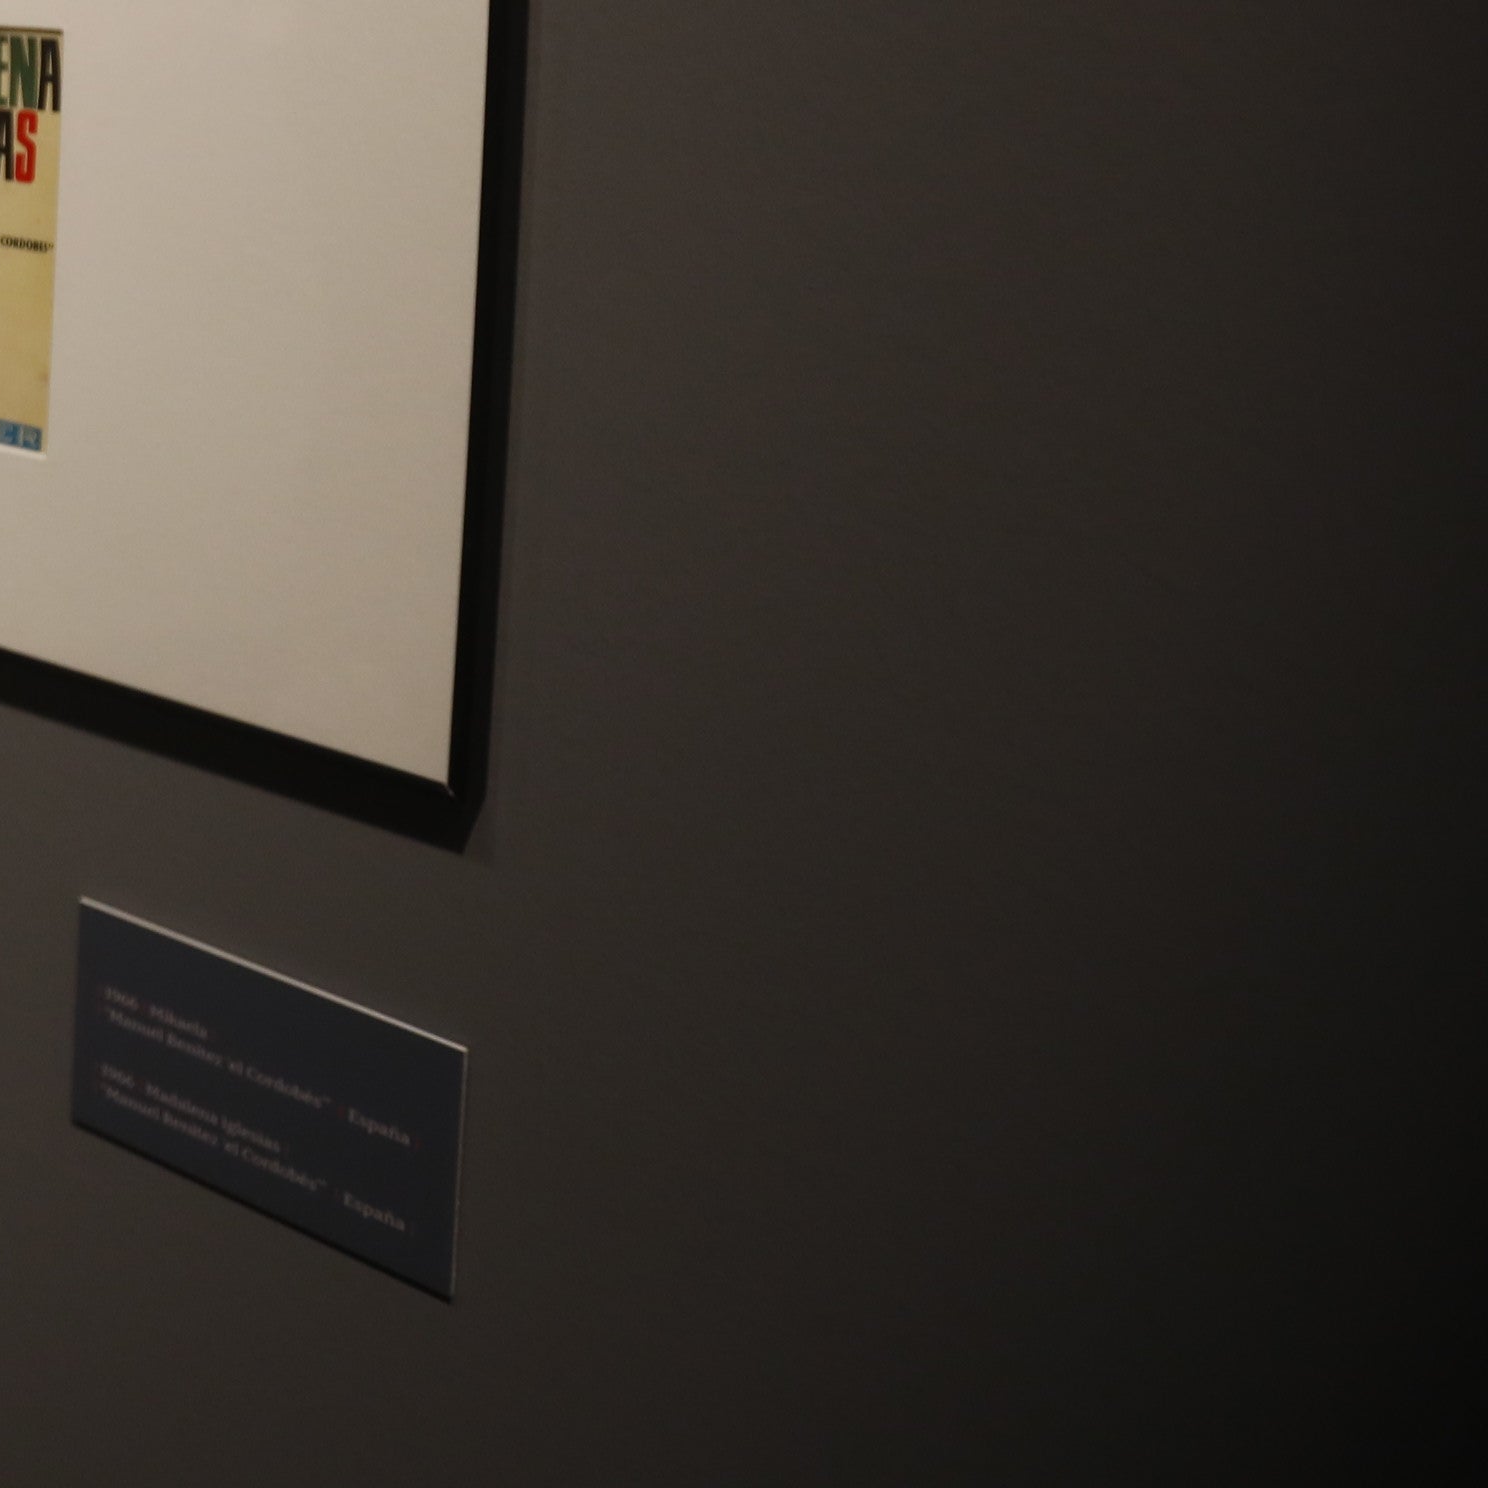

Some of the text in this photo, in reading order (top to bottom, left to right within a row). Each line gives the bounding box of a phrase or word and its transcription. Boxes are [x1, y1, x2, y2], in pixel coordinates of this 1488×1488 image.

[148, 1002, 208, 1040] Mikaela
[347, 1107, 411, 1152] España
[342, 1190, 405, 1235] España
